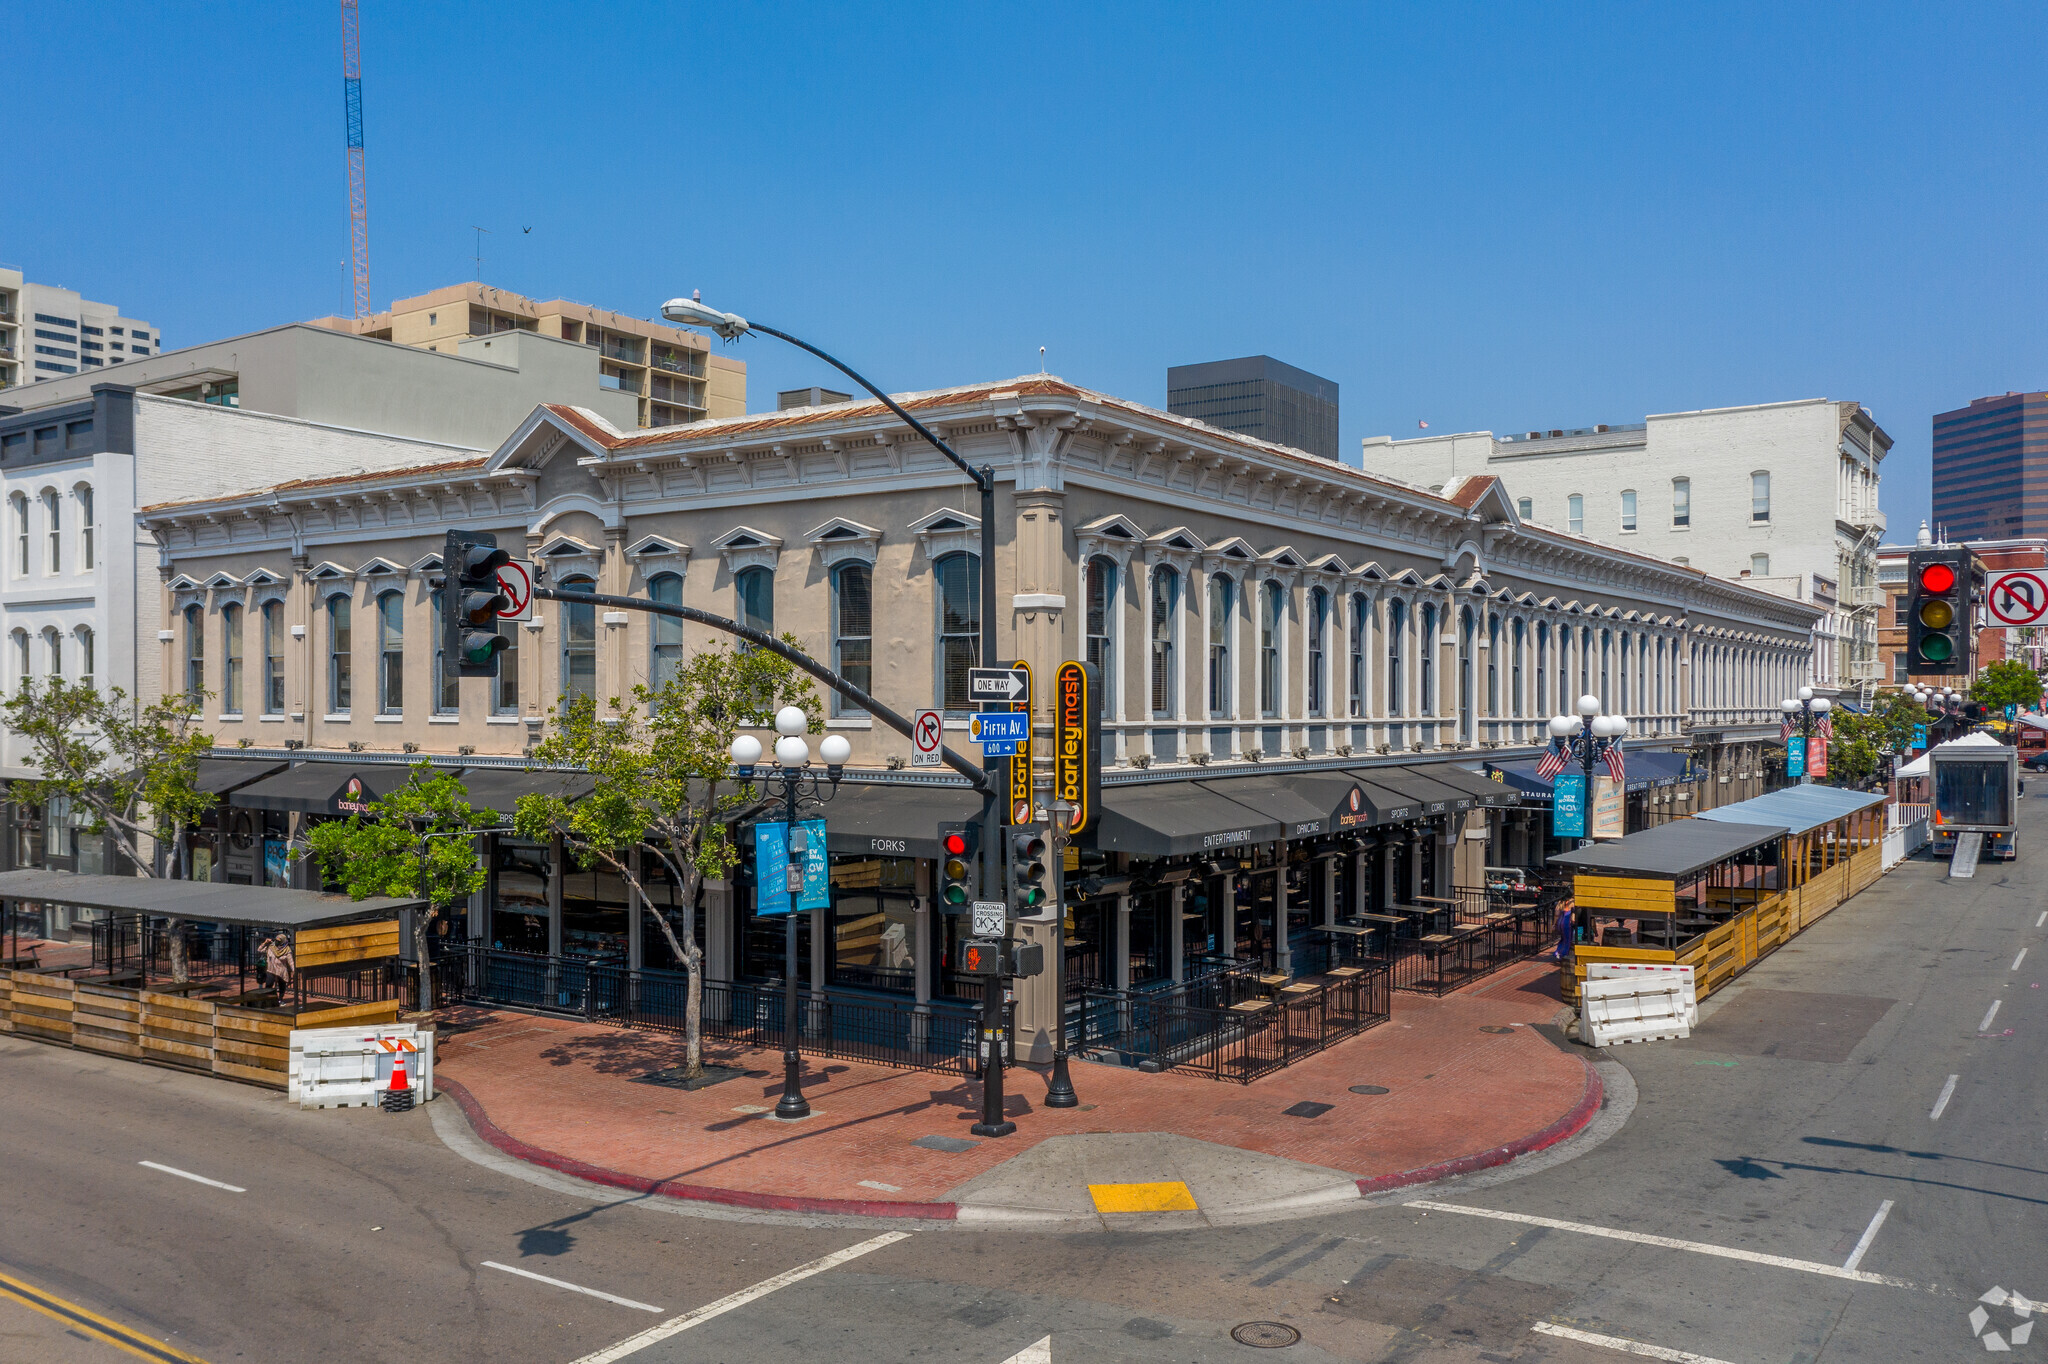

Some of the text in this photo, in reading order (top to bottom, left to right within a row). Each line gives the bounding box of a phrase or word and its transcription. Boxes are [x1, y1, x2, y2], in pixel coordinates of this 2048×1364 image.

[978, 680, 1009, 690] ONE WAY
[983, 720, 1006, 736] FIFTH
[1060, 669, 1082, 800] barleymash
[988, 743, 1000, 753] 600
[914, 754, 939, 763] ON RED
[338, 799, 369, 813] barleyma
[1391, 808, 1409, 819] SPORTS
[1431, 802, 1445, 813] CORKS
[1457, 800, 1470, 809] FORKS
[1485, 796, 1495, 804] TAPS
[1558, 804, 1582, 812] NOW
[500, 813, 514, 824] APS
[1340, 811, 1368, 827] barleymash
[1204, 821, 1320, 848] ENTERTAINMENT DANCING
[871, 839, 906, 852] FORKS
[975, 917, 988, 928] OK
